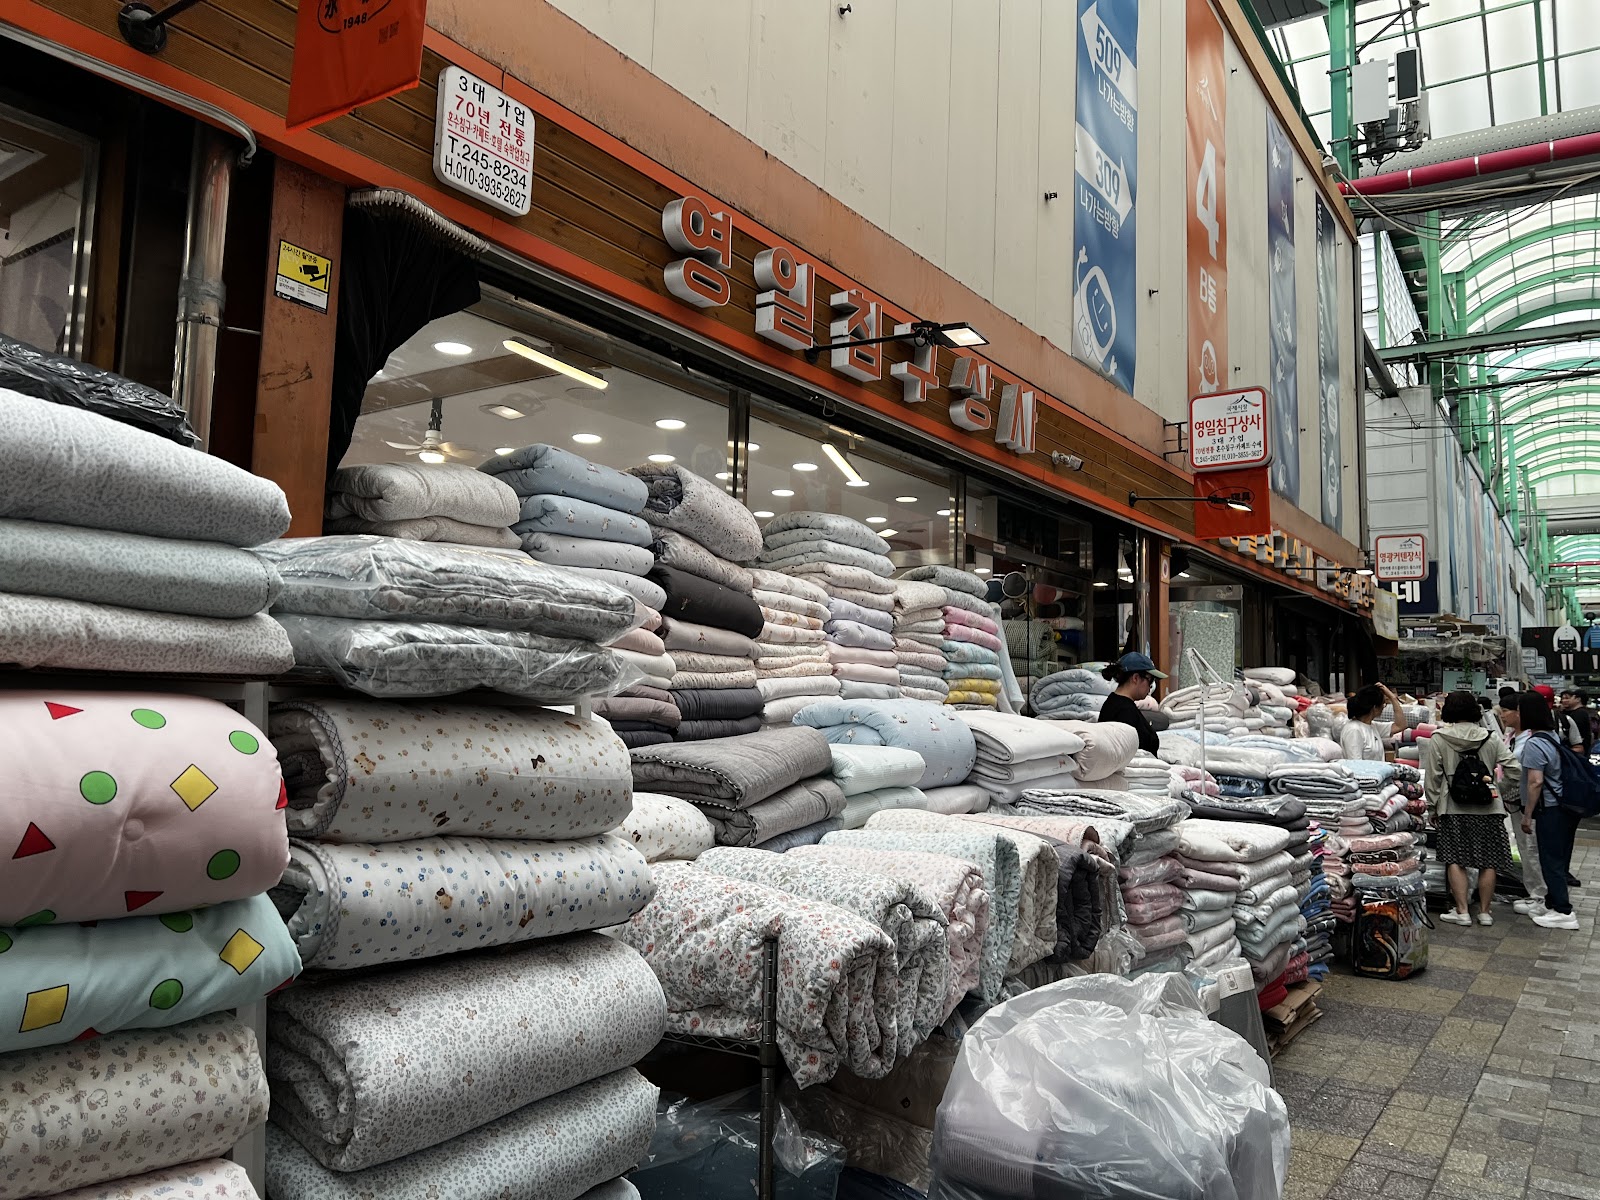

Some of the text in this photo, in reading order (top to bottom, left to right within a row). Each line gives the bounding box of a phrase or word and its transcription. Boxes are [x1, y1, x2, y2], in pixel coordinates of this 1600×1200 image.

[343, 12, 368, 29] 1948
[1096, 23, 1122, 83] 509
[455, 94, 526, 147] 70년 전통
[497, 96, 525, 127] 가업
[1098, 74, 1134, 133] 나가는방향
[445, 155, 527, 210] H.010-3935-2627
[448, 135, 527, 190] T.245-8234
[1096, 151, 1120, 204] 309
[1080, 185, 1119, 239] 나가는방향
[1196, 138, 1219, 260] 4
[1200, 266, 1217, 314] B동
[662, 196, 1038, 454] 영일침구상사
[1194, 414, 1261, 438] 영일침구상사
